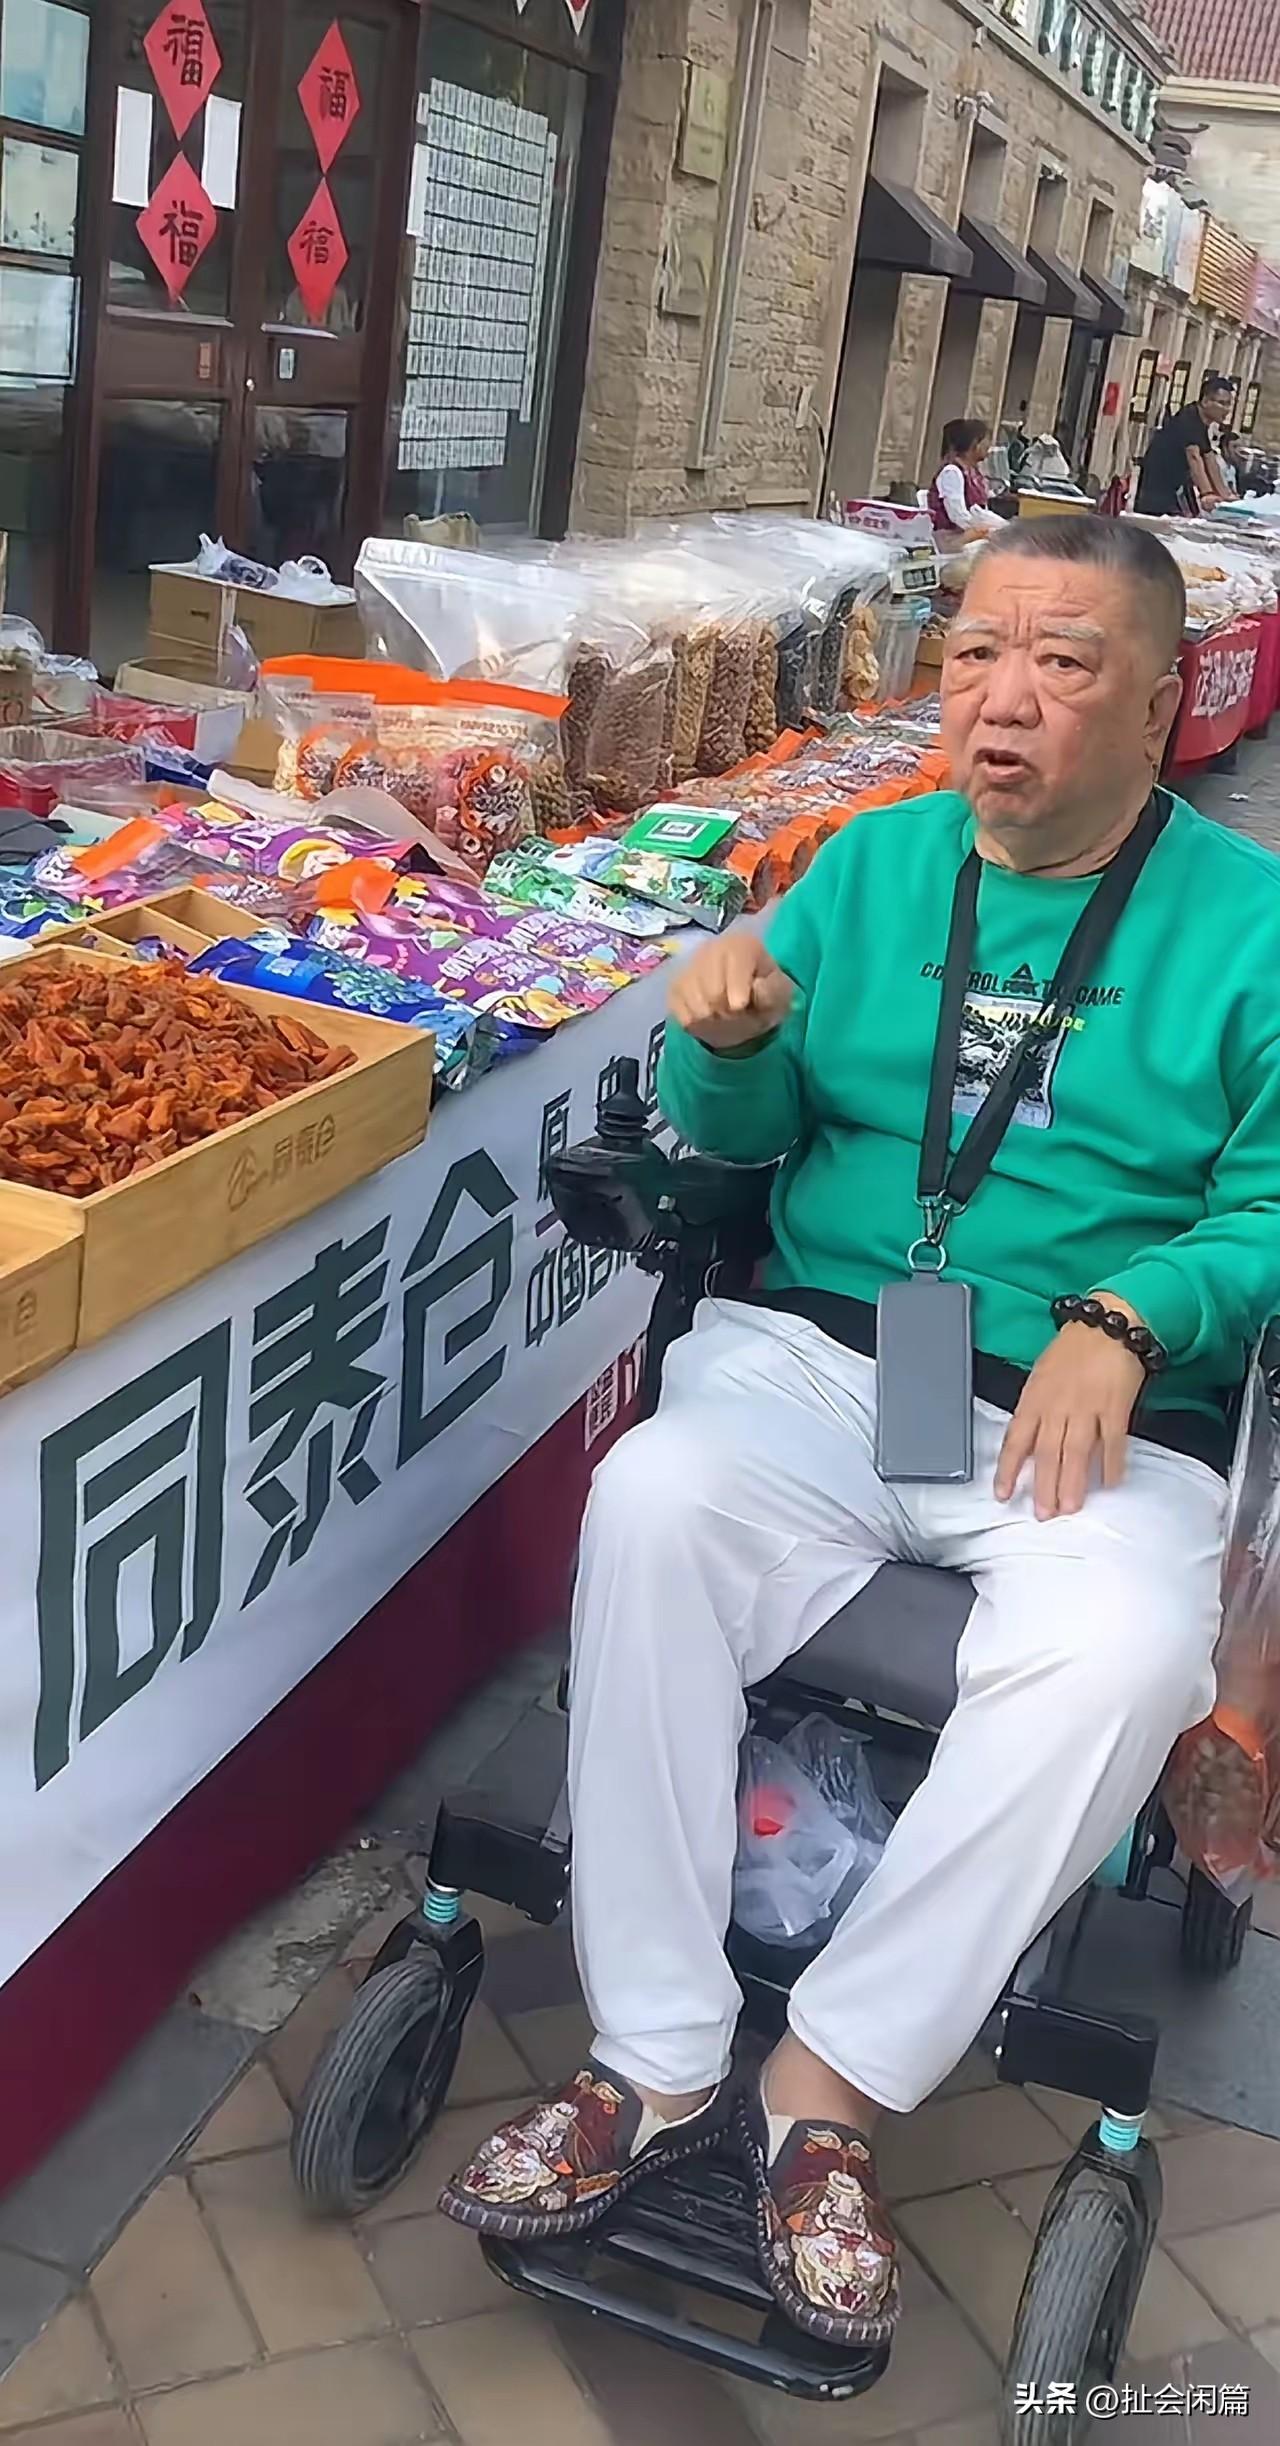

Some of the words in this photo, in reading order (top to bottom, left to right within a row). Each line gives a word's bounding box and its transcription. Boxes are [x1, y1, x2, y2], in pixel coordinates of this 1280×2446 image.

[162, 14, 205, 88] 福
[319, 66, 349, 122] 福
[160, 200, 204, 268] 福
[920, 961, 999, 993] COROL
[34, 1147, 519, 1792] 同泰仓
